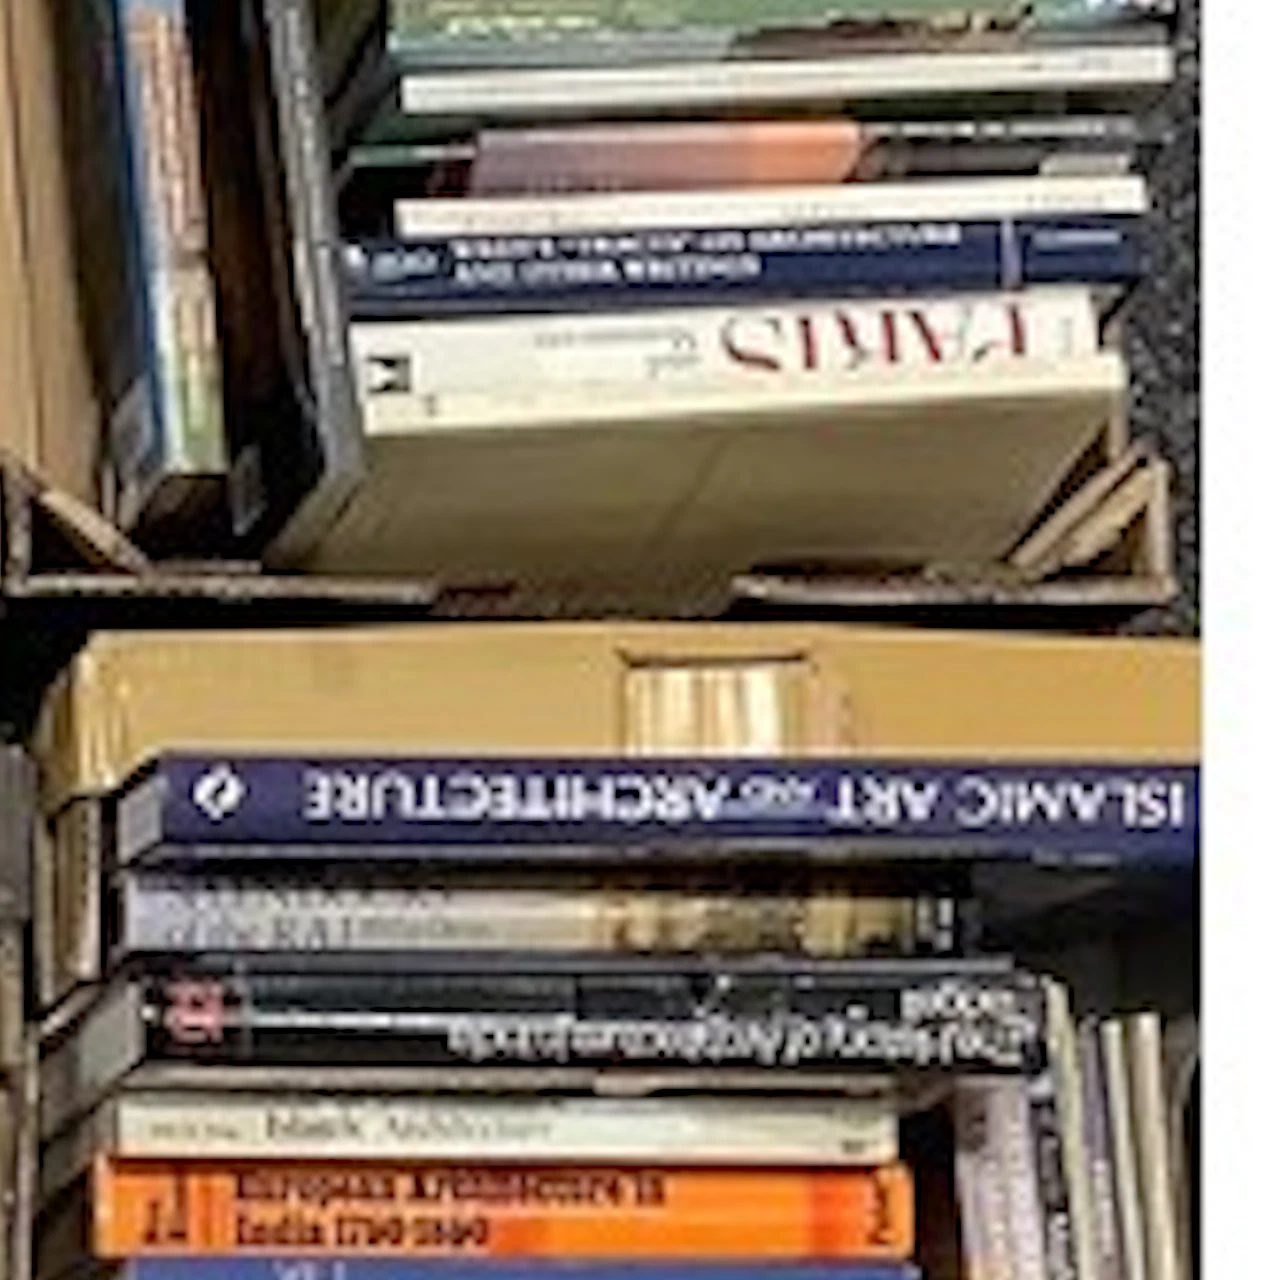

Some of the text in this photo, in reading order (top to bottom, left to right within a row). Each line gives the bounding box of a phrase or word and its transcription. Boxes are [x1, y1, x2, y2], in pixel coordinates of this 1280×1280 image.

[718, 302, 1028, 373] PARIS
[303, 772, 731, 824] ARCHITECTURE
[831, 774, 944, 826] ART
[958, 775, 1186, 828] ISLAMIC
[957, 1024, 1024, 1066] The
[233, 1210, 328, 1247] India
